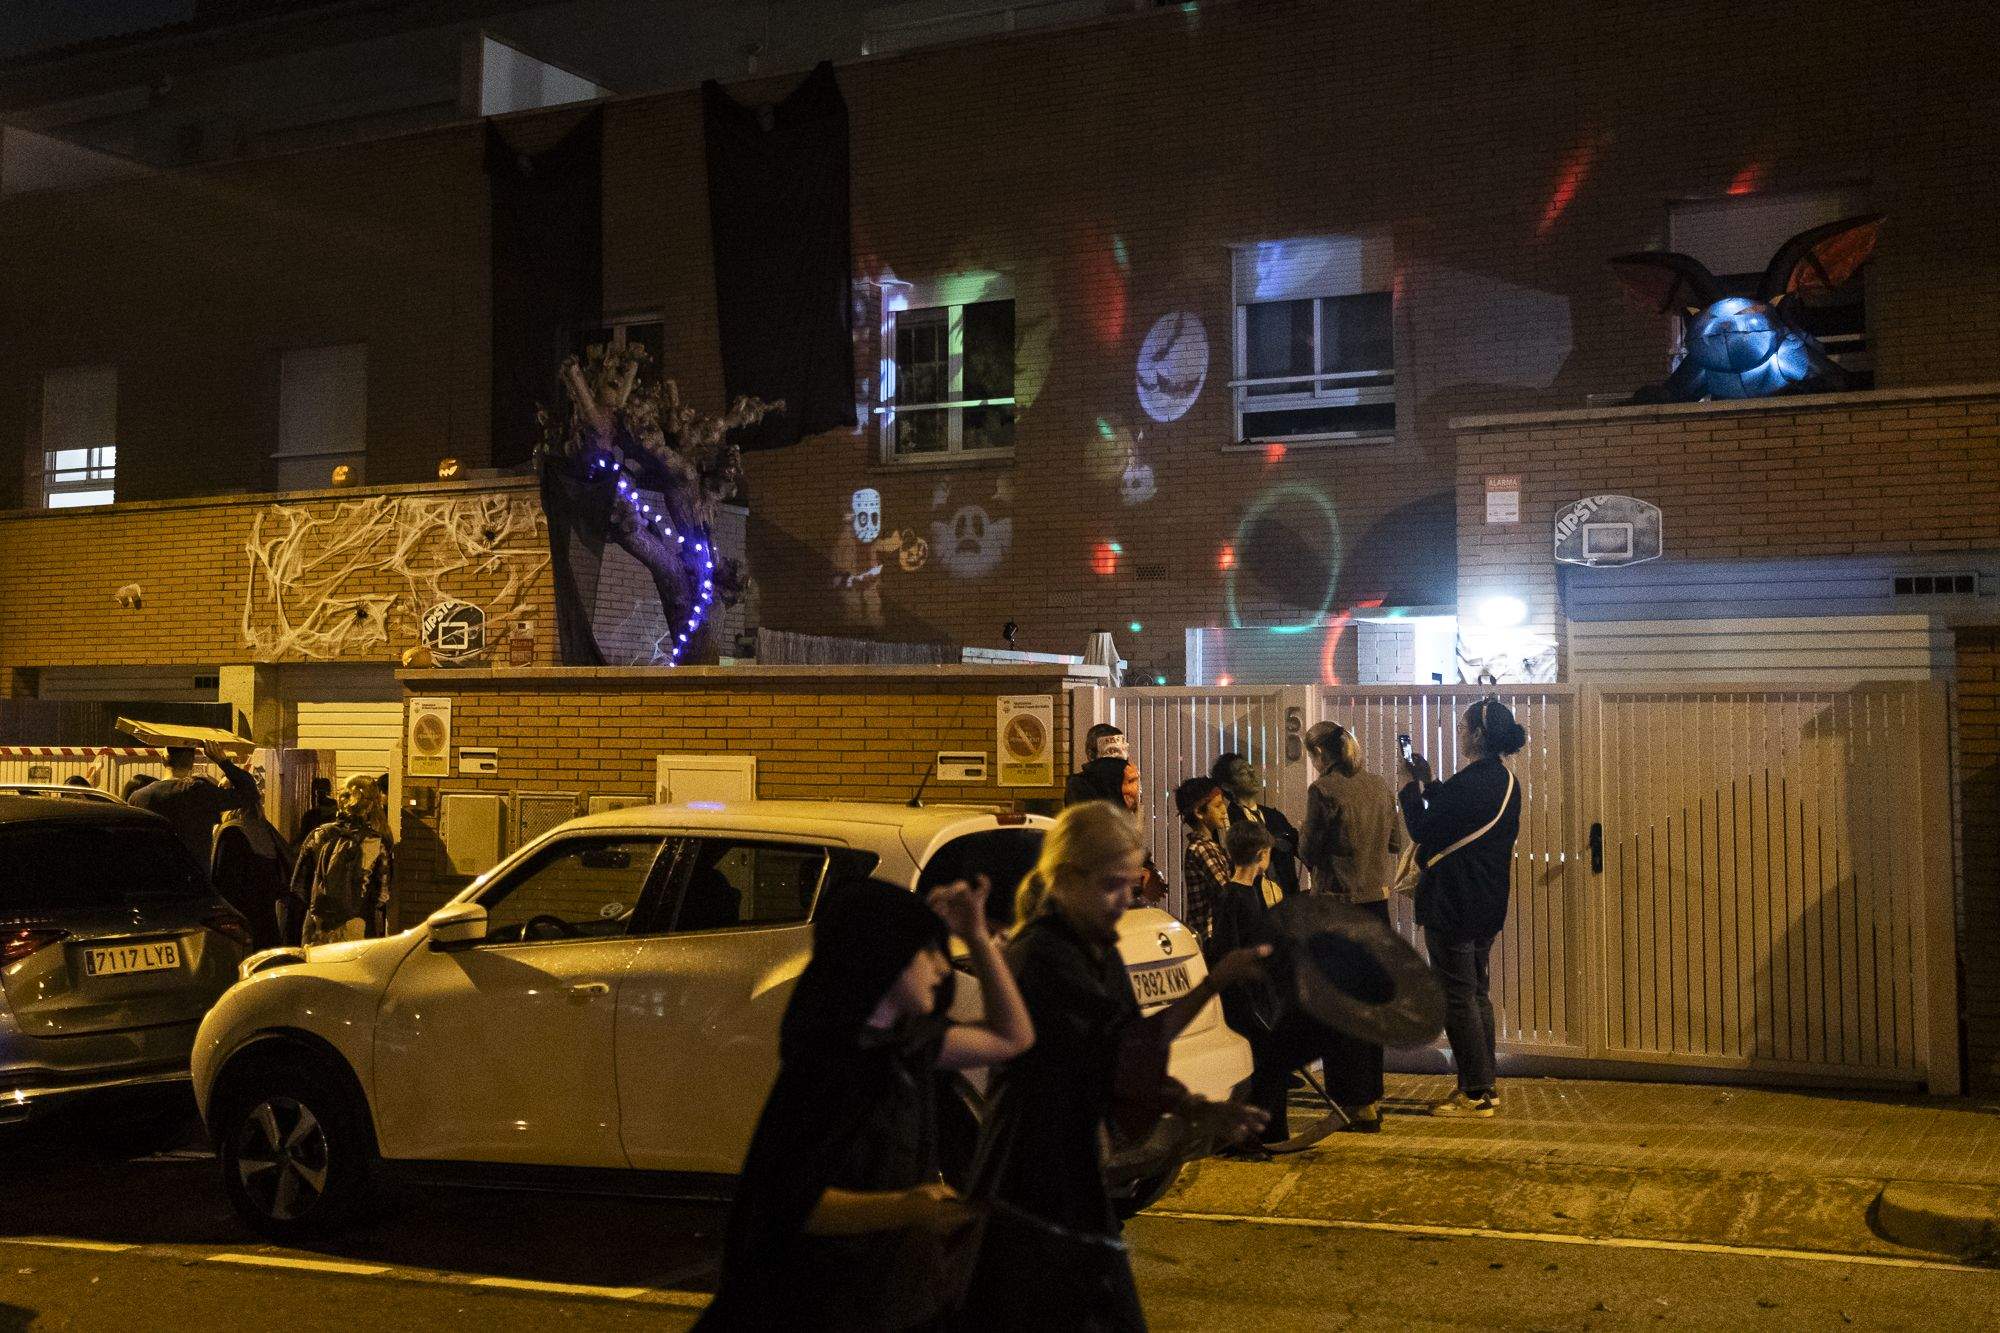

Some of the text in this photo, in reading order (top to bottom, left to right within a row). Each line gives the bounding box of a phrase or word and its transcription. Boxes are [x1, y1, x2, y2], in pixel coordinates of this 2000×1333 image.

[1488, 478, 1519, 488] ALARMA
[96, 945, 176, 971] 7117 LYB
[1133, 971, 1166, 999] 7892
